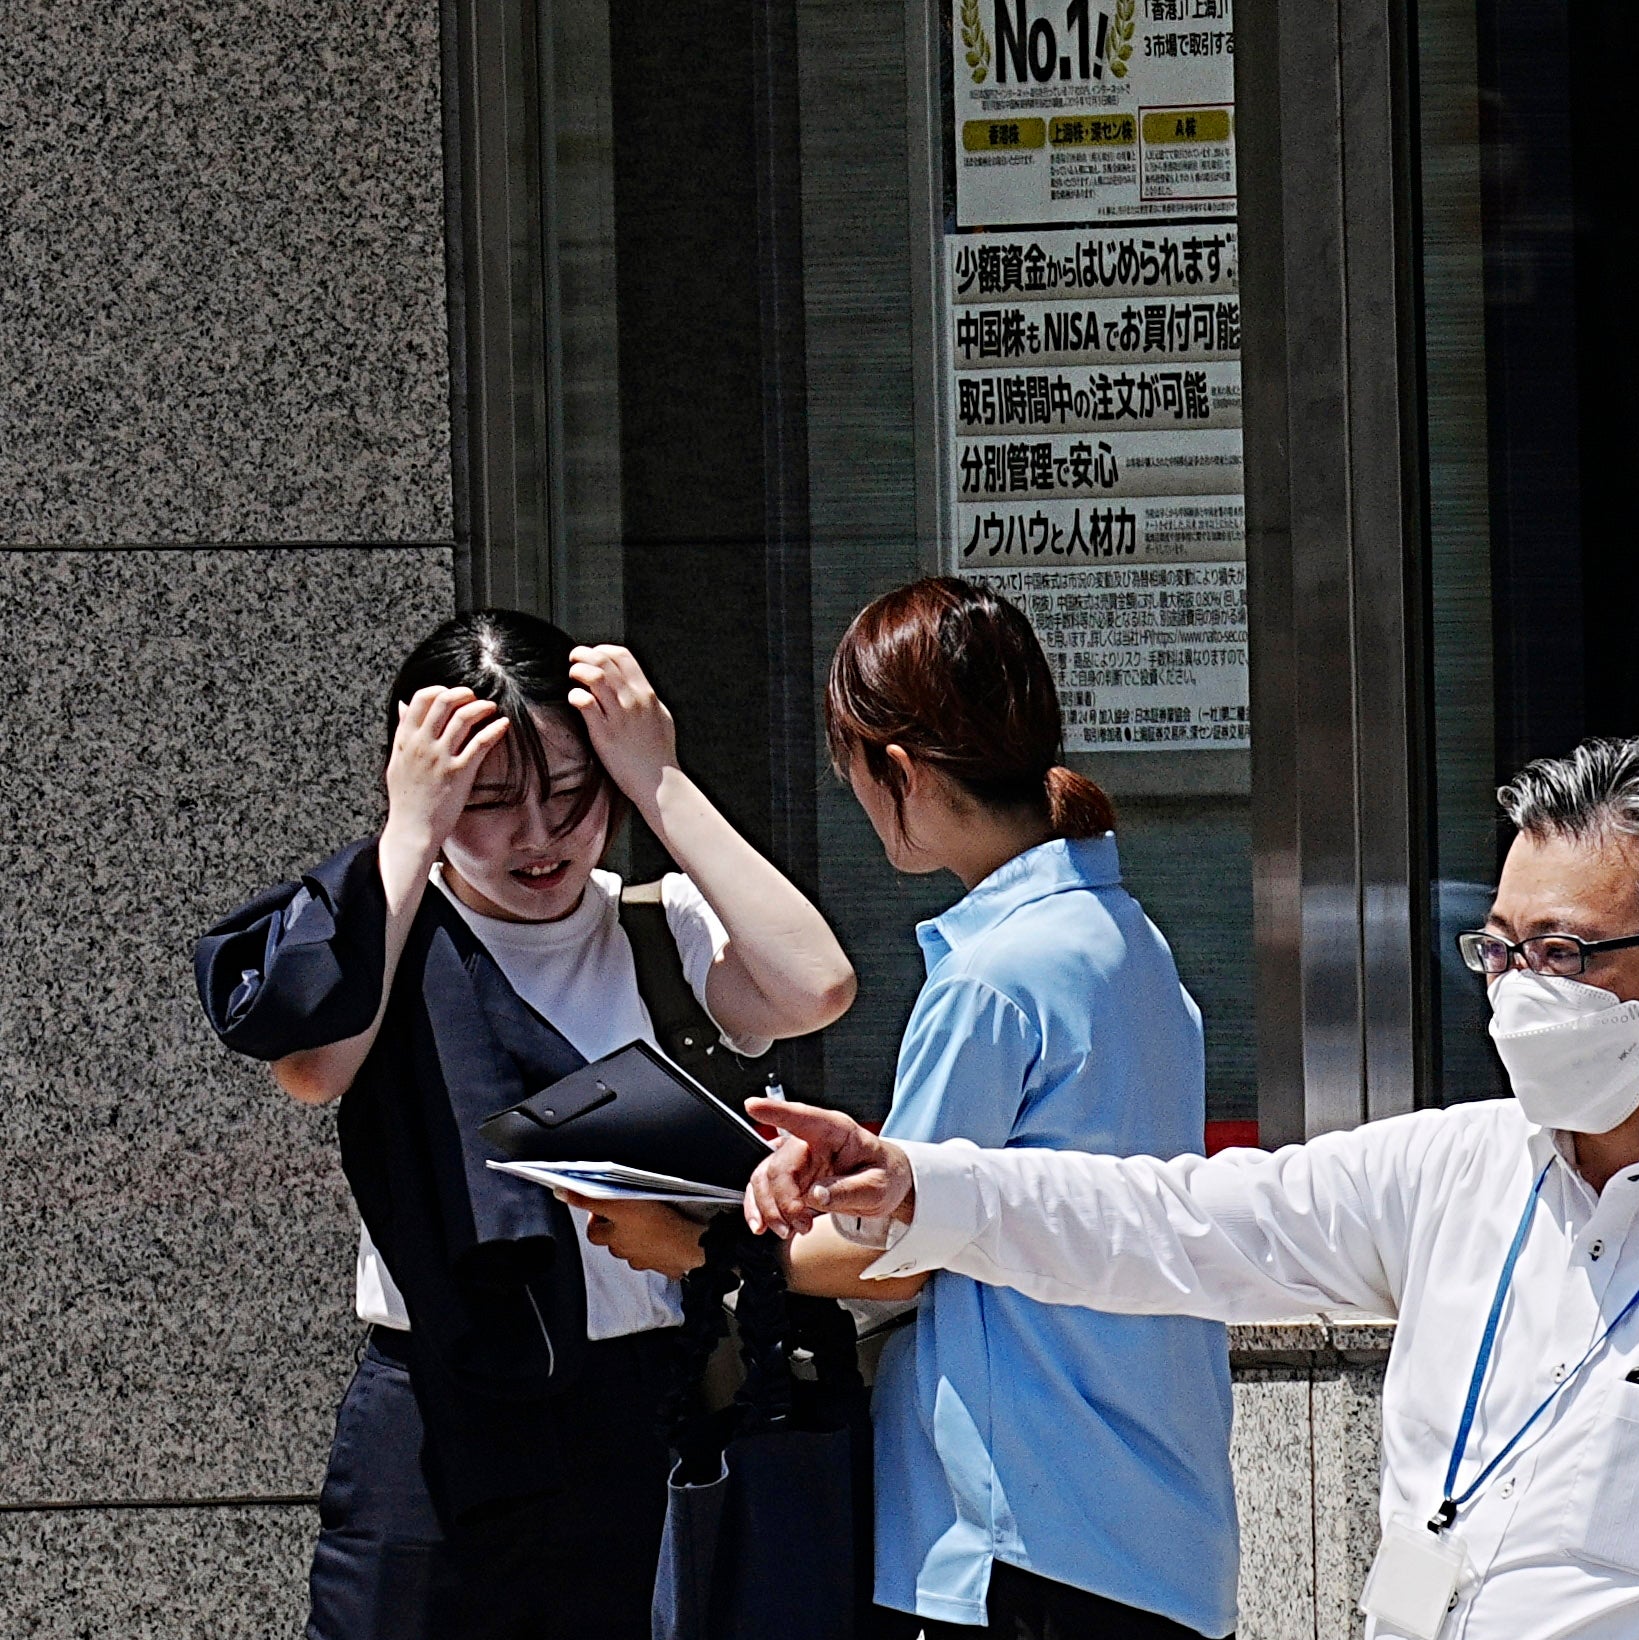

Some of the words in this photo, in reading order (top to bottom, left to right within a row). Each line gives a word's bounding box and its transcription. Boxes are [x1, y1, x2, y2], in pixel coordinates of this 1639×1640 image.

[958, 371, 1210, 426] 取引時間中の注文が可能
[960, 440, 1119, 493] 分別管理で安心
[963, 506, 1136, 557] ノウハウと人材力
